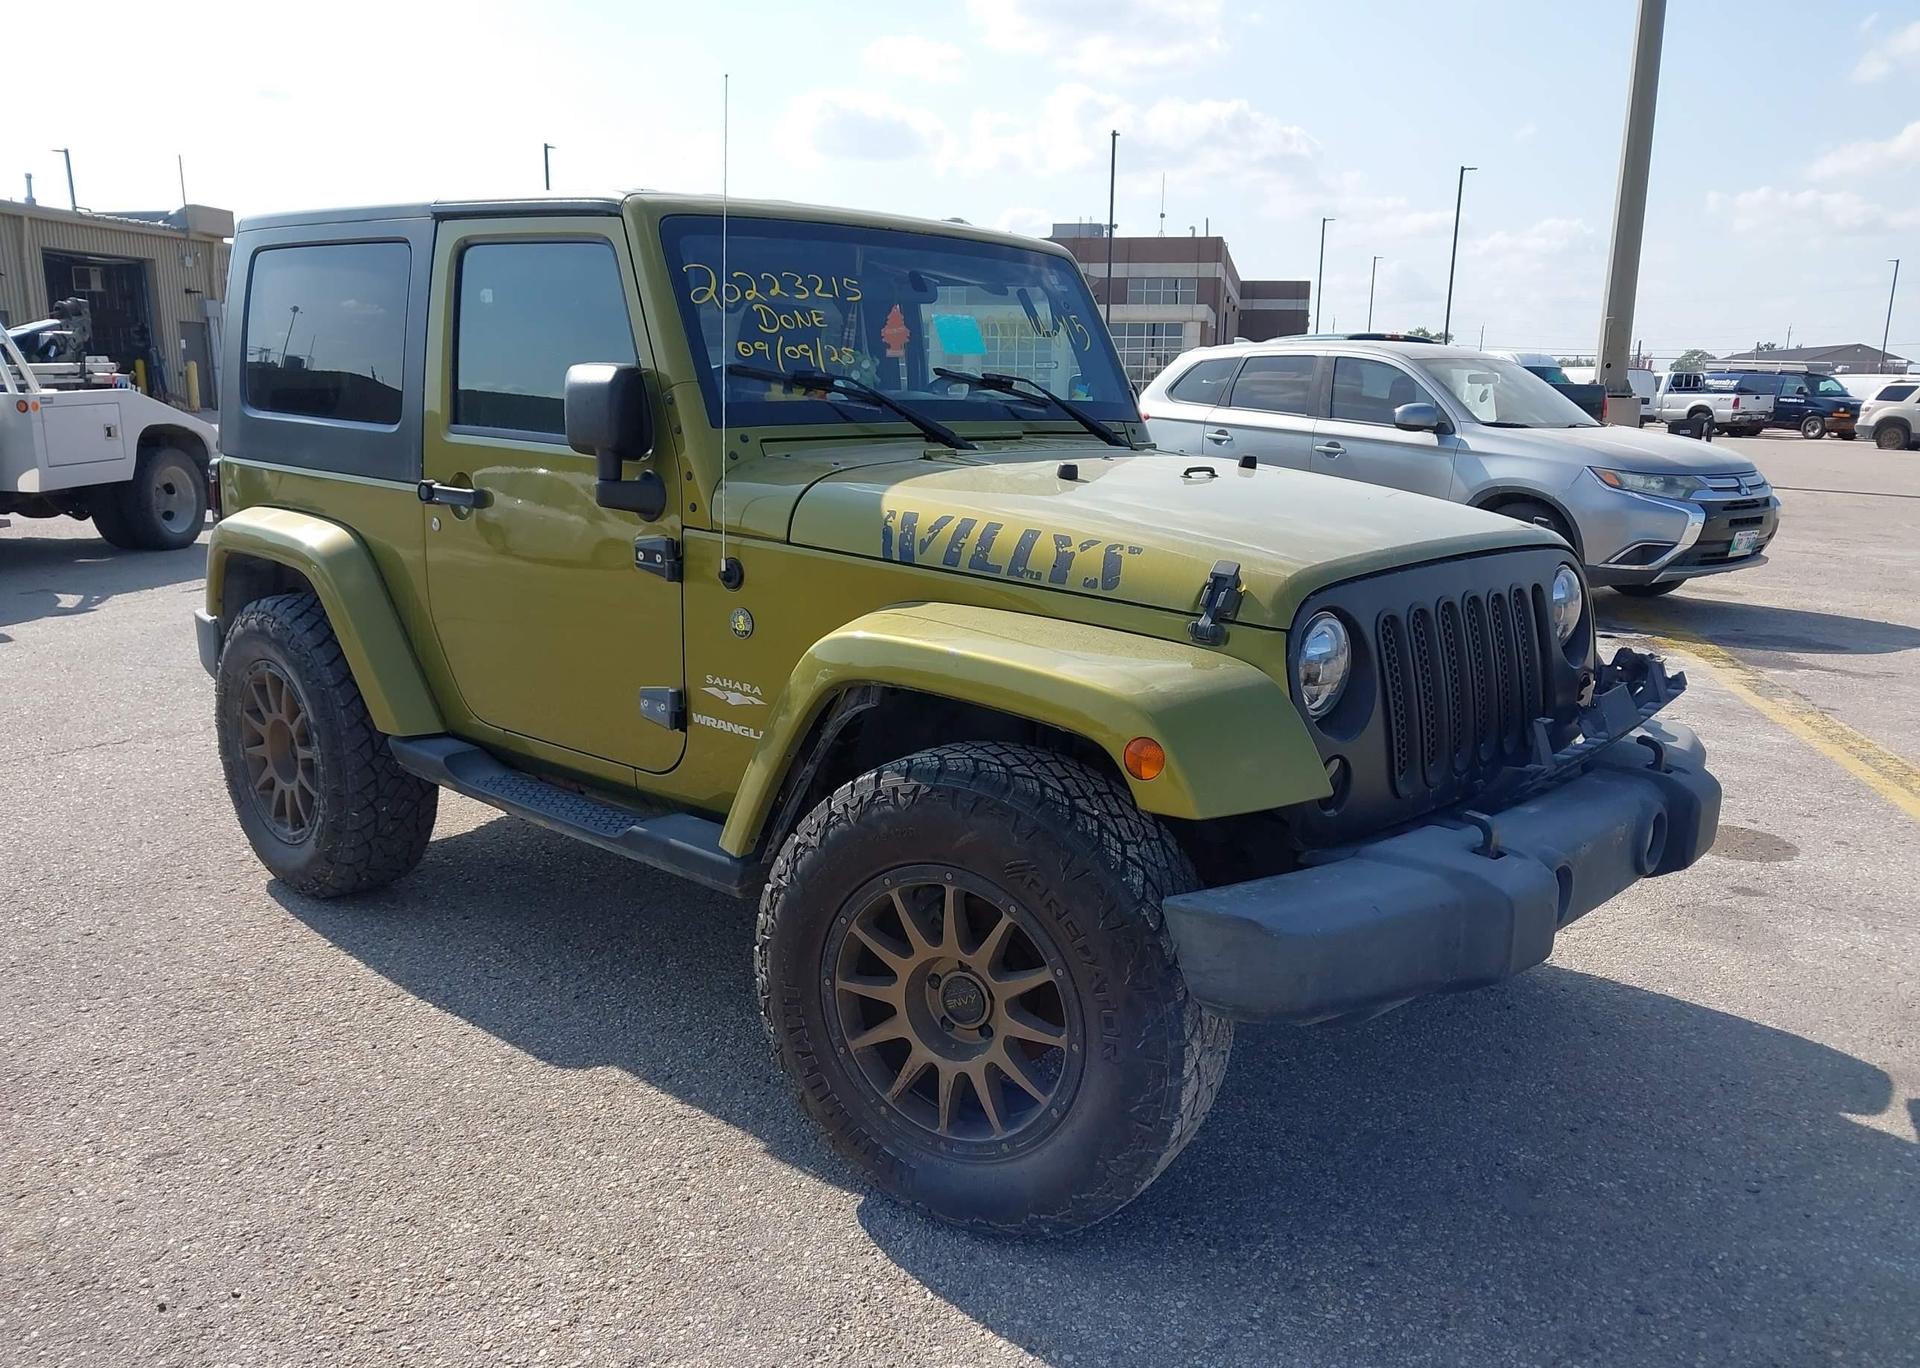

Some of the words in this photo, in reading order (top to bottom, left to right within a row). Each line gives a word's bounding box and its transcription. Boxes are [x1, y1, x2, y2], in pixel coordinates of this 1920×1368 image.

[682, 263, 863, 310] 20223215
[736, 335, 856, 374] 09/09/25
[704, 674, 763, 696] SAHARA
[945, 992, 977, 1009] ENVY
